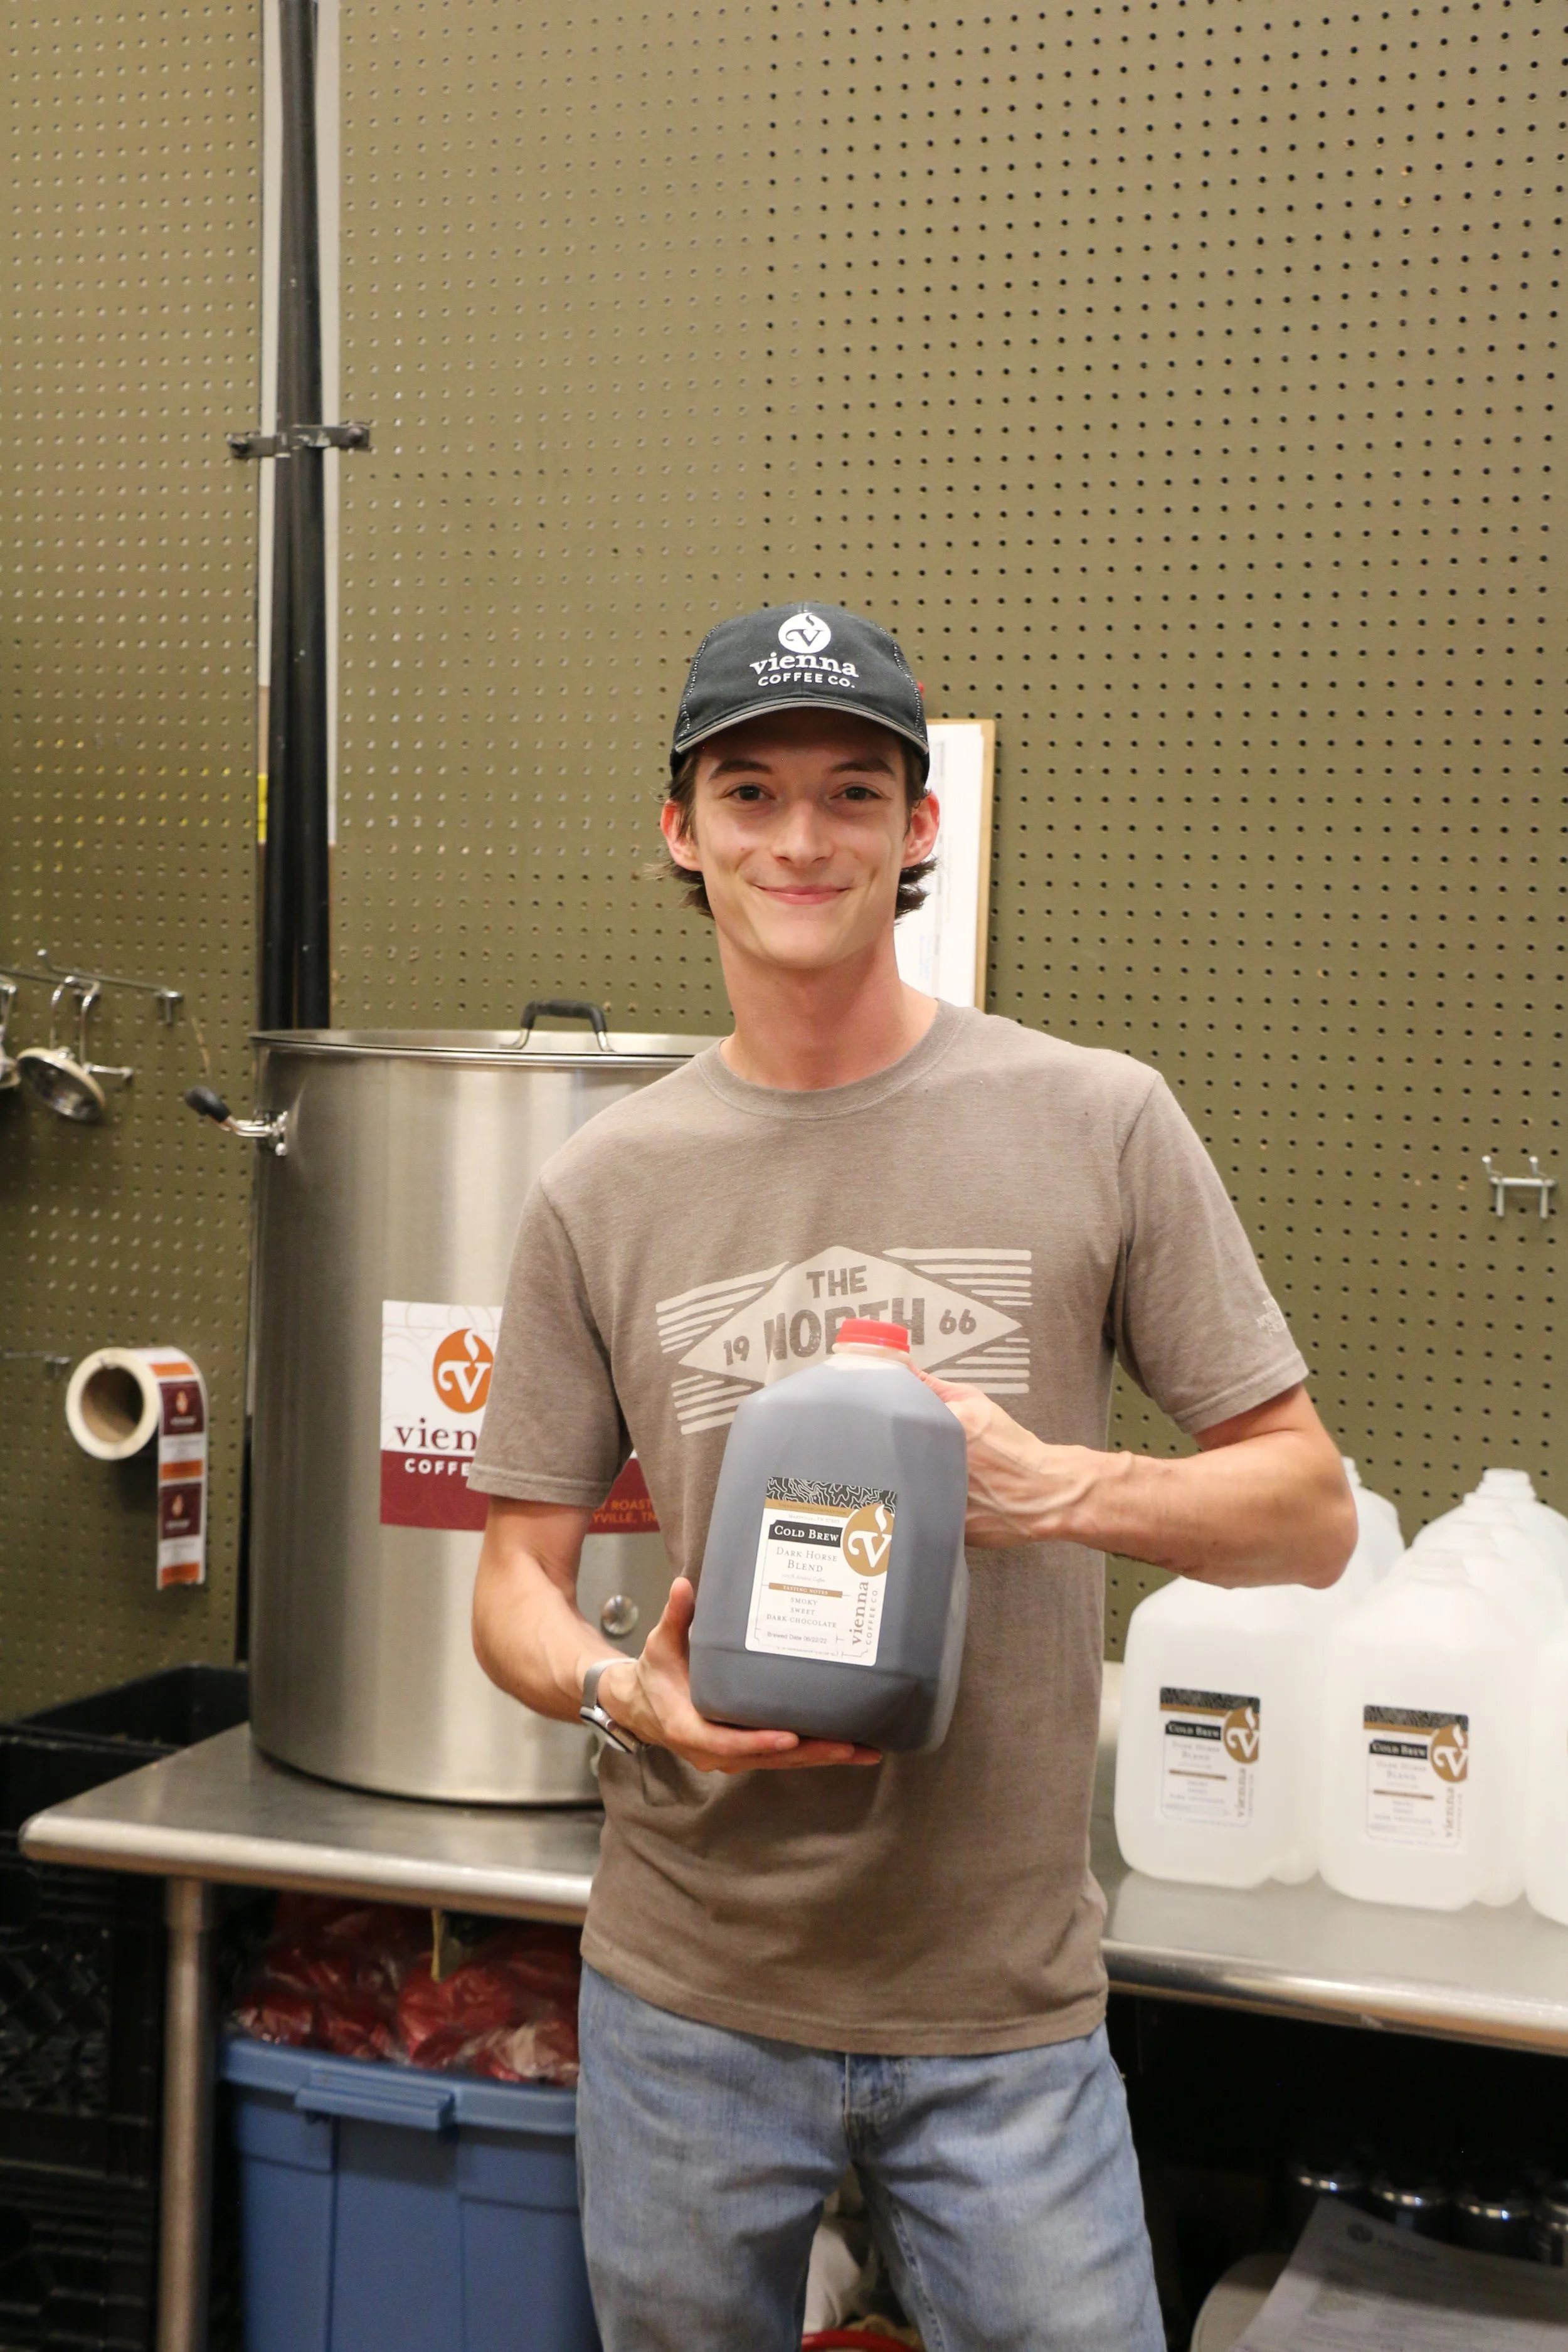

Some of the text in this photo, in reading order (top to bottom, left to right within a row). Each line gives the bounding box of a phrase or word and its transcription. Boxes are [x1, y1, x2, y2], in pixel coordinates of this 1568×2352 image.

[750, 652, 859, 677] vienna
[758, 672, 856, 688] COFFEE CO.
[807, 1265, 867, 1298] THE
[939, 1308, 977, 1335] 66
[723, 1336, 750, 1365] 19
[774, 1525, 839, 1542] COLD BREW
[776, 1547, 837, 1562] DARK HORSE
[787, 1559, 823, 1572] BLEND
[790, 1597, 818, 1606] SMOKY
[790, 1607, 815, 1616] SWEET
[849, 1581, 869, 1645] vienna
[790, 1617, 837, 1628] CHOCOLATE
[866, 1606, 876, 1646] COFFEE
